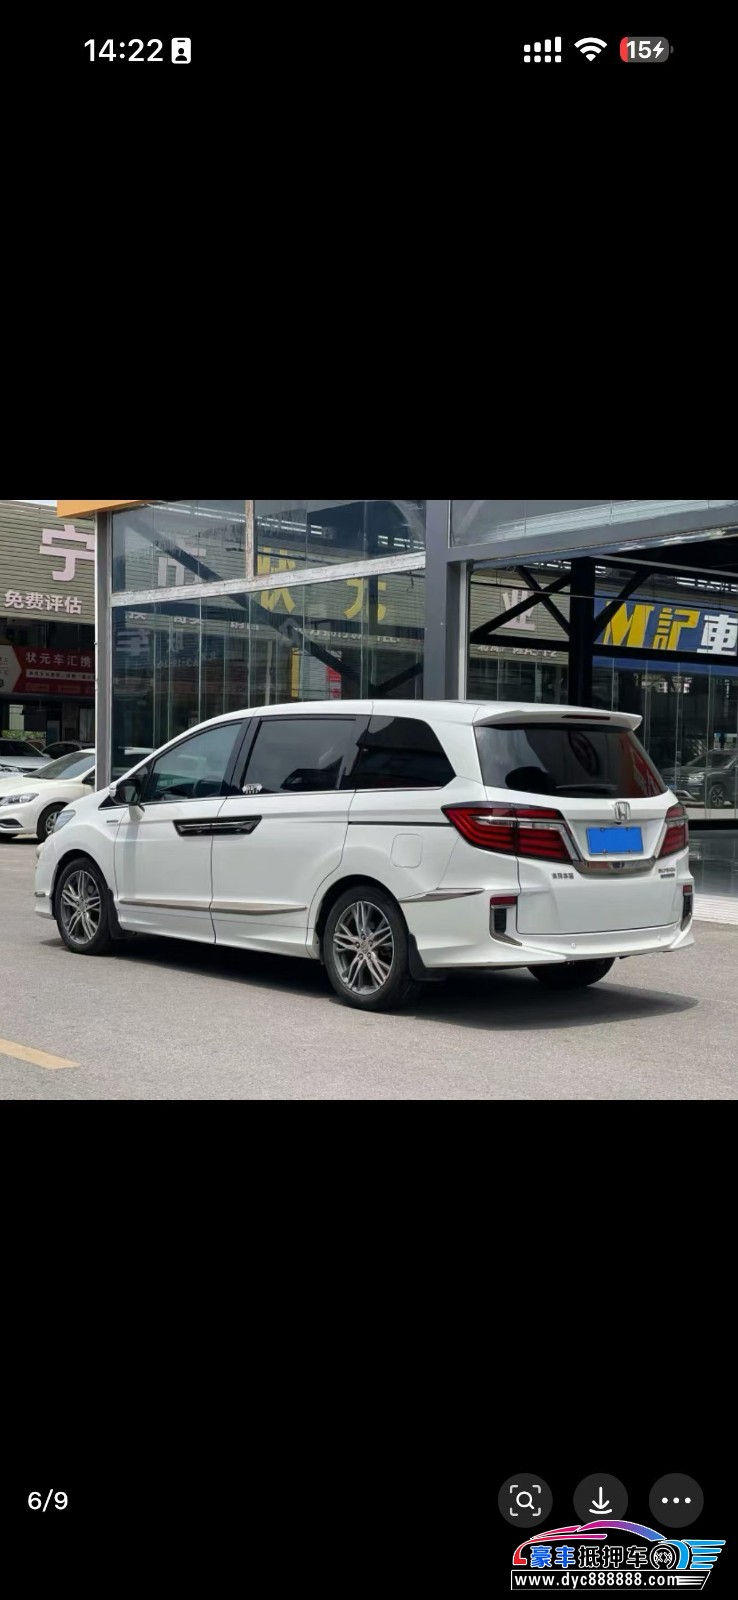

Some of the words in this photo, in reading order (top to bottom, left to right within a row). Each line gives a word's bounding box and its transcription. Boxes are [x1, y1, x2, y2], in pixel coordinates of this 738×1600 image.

[40, 525, 95, 581] 宁
[4, 590, 82, 614] 免费评估
